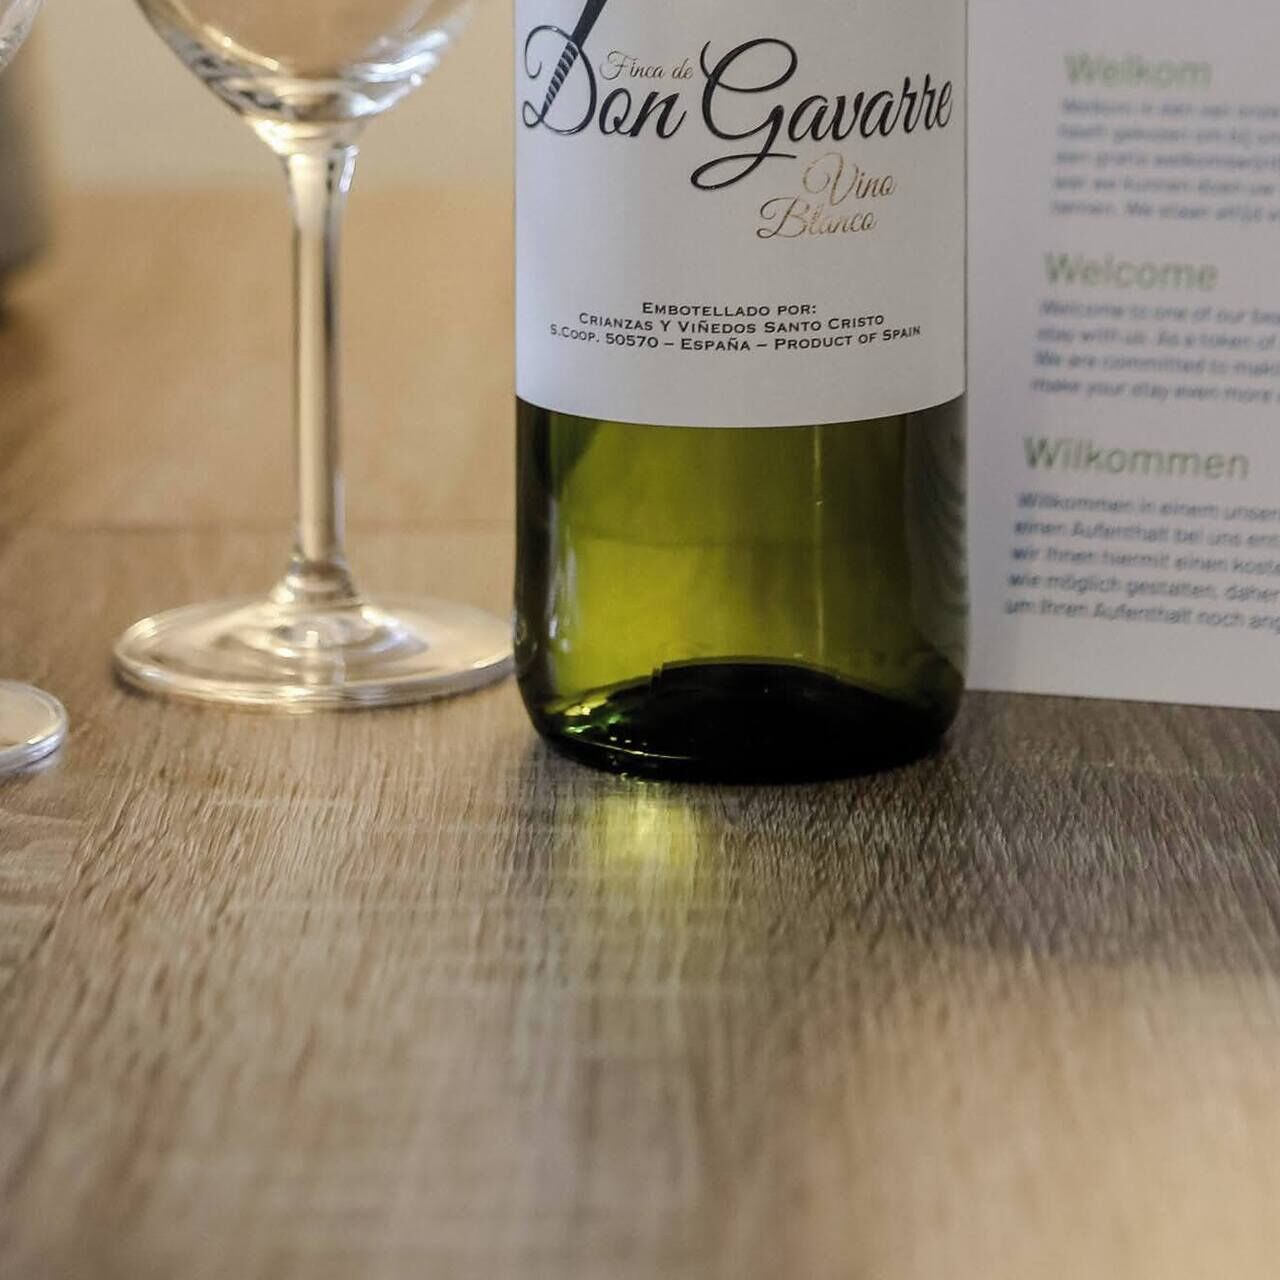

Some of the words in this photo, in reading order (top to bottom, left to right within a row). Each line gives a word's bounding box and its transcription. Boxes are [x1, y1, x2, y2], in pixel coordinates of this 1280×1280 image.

[599, 49, 665, 81] Finca
[671, 58, 694, 80] de
[1063, 53, 1213, 89] Welkom
[522, 24, 686, 139] Don
[690, 37, 953, 190] Gavarre
[802, 151, 897, 207] Vino
[756, 196, 878, 240] Blanco
[1042, 252, 1219, 293] Welcome
[578, 312, 653, 332] CRIANZAS
[661, 320, 669, 332] Y
[679, 320, 756, 334] VIÑEDOS
[764, 320, 820, 334] SANTO
[828, 315, 885, 330] CRISTO
[643, 302, 770, 317] EMBOTELLADO
[605, 332, 658, 349] 50570
[680, 337, 750, 352] ESPAÑA
[774, 335, 853, 351] PRODUCT
[858, 331, 876, 344] OF
[882, 325, 921, 341] SPAIN
[1023, 437, 1250, 480] Wilkommen
[1223, 583, 1279, 602] daher
